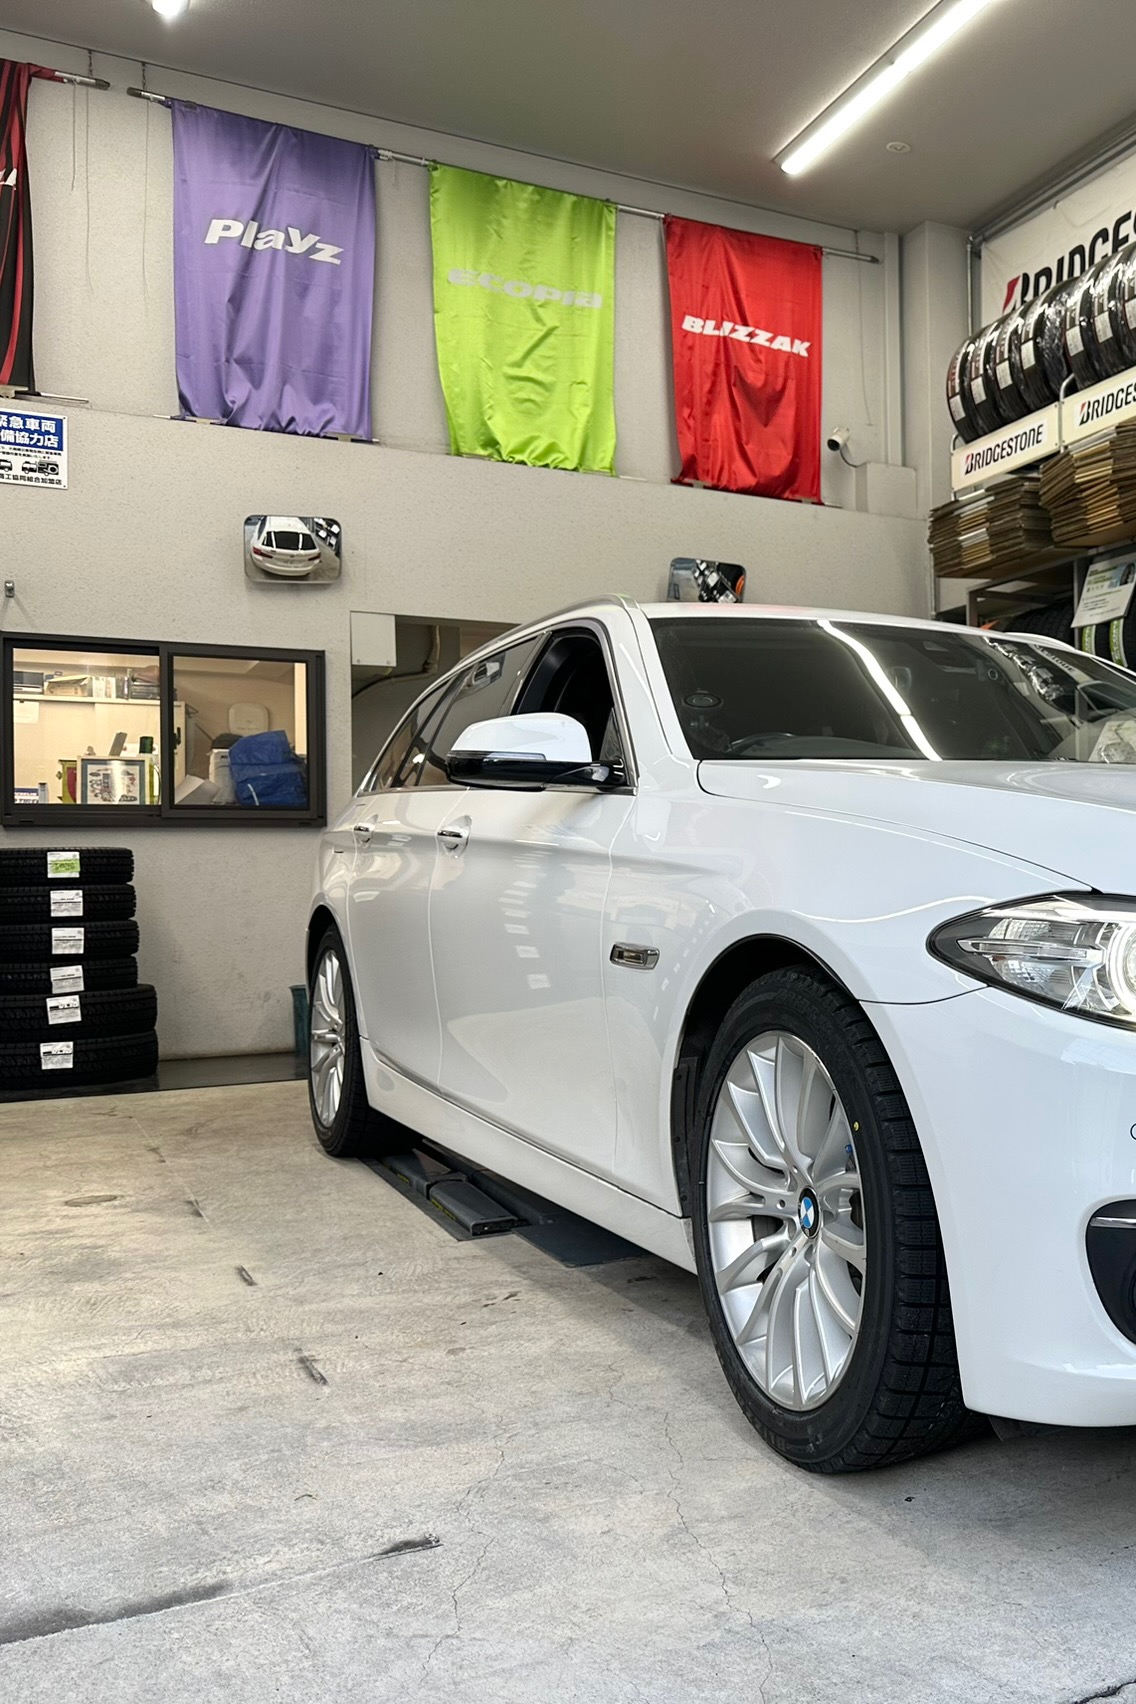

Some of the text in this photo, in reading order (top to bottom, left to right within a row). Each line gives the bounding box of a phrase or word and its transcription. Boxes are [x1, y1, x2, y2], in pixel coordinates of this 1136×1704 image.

[204, 219, 344, 265] Playz
[682, 315, 811, 358] BLIZZAK
[964, 424, 1043, 474] BRIDGESTONE
